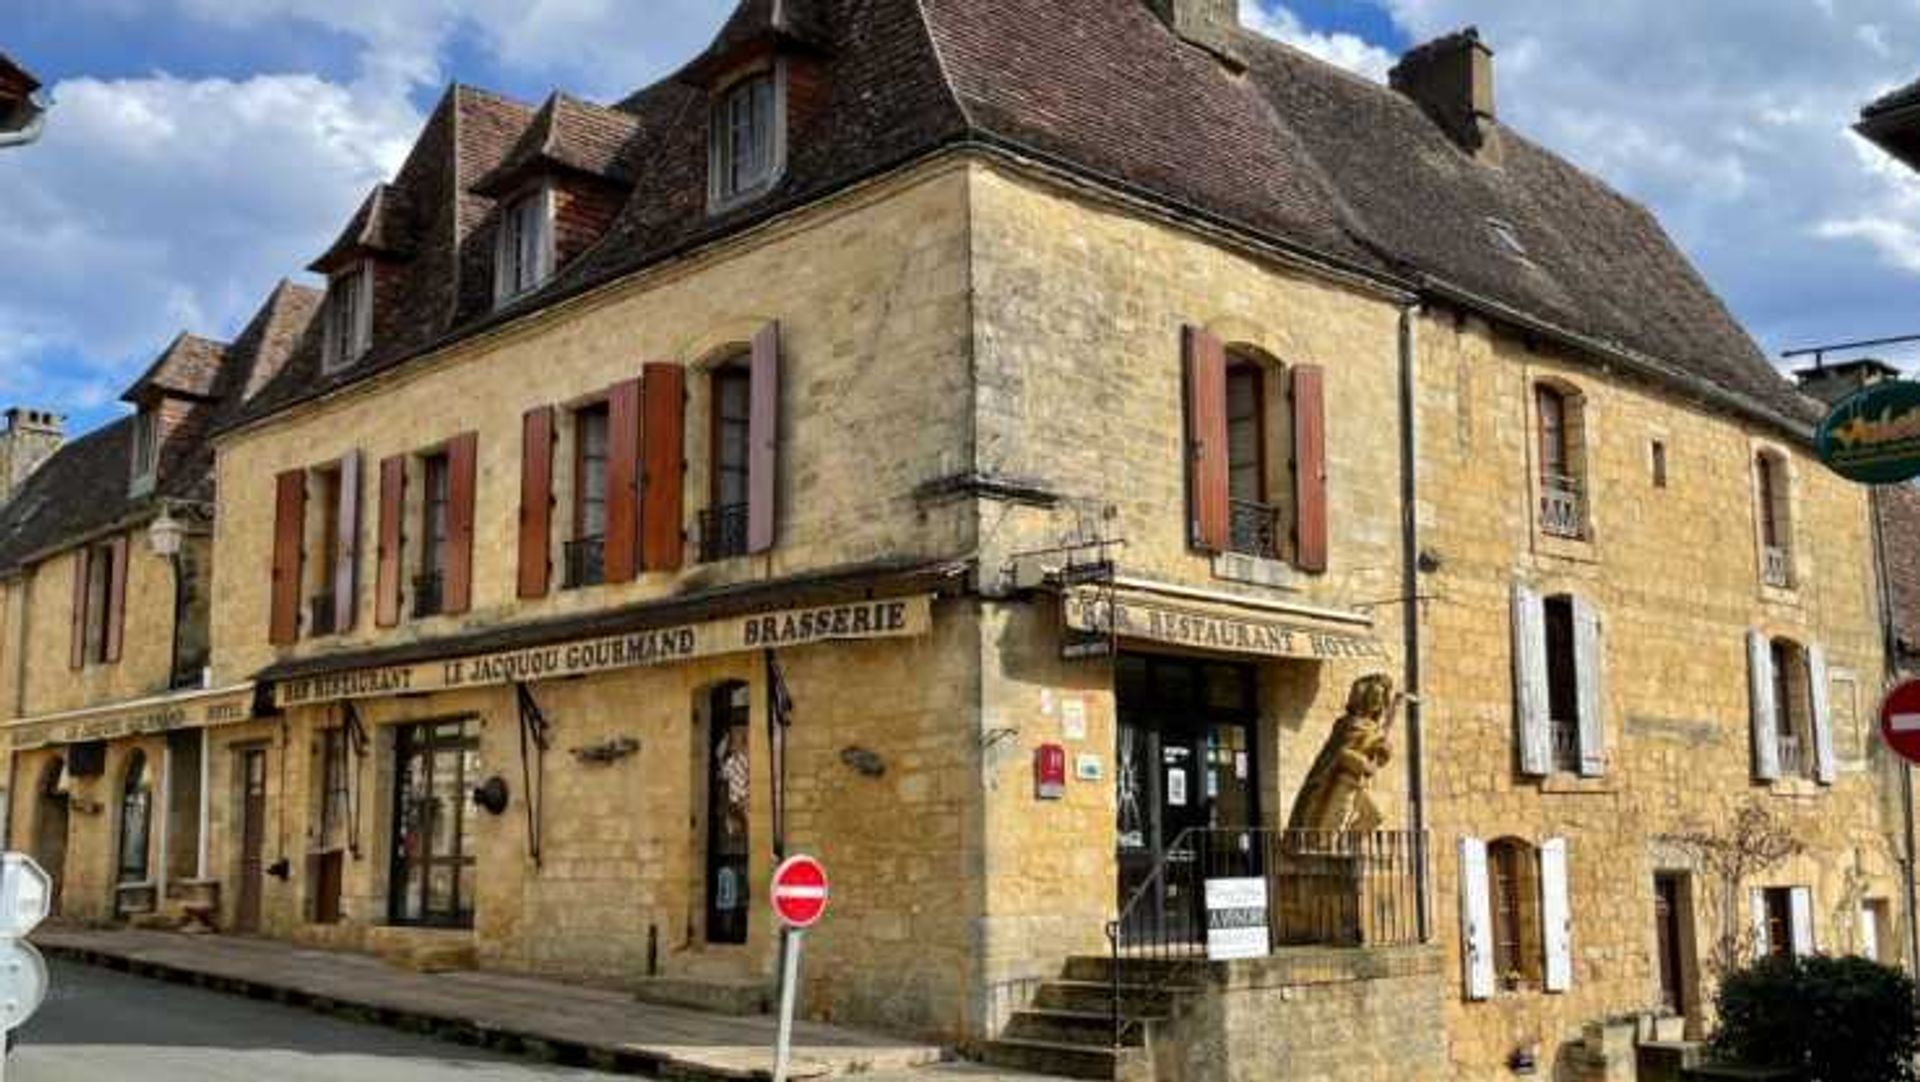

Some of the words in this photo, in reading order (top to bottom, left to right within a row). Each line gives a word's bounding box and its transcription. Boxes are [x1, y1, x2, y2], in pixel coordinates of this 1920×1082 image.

[314, 665, 413, 697] RESTAURANT
[443, 663, 461, 687] LE
[471, 649, 559, 682] JACQUOU
[566, 628, 695, 669] GOURMAND
[744, 602, 906, 646] BRASSERIE
[1150, 609, 1293, 654] RESTAURANT
